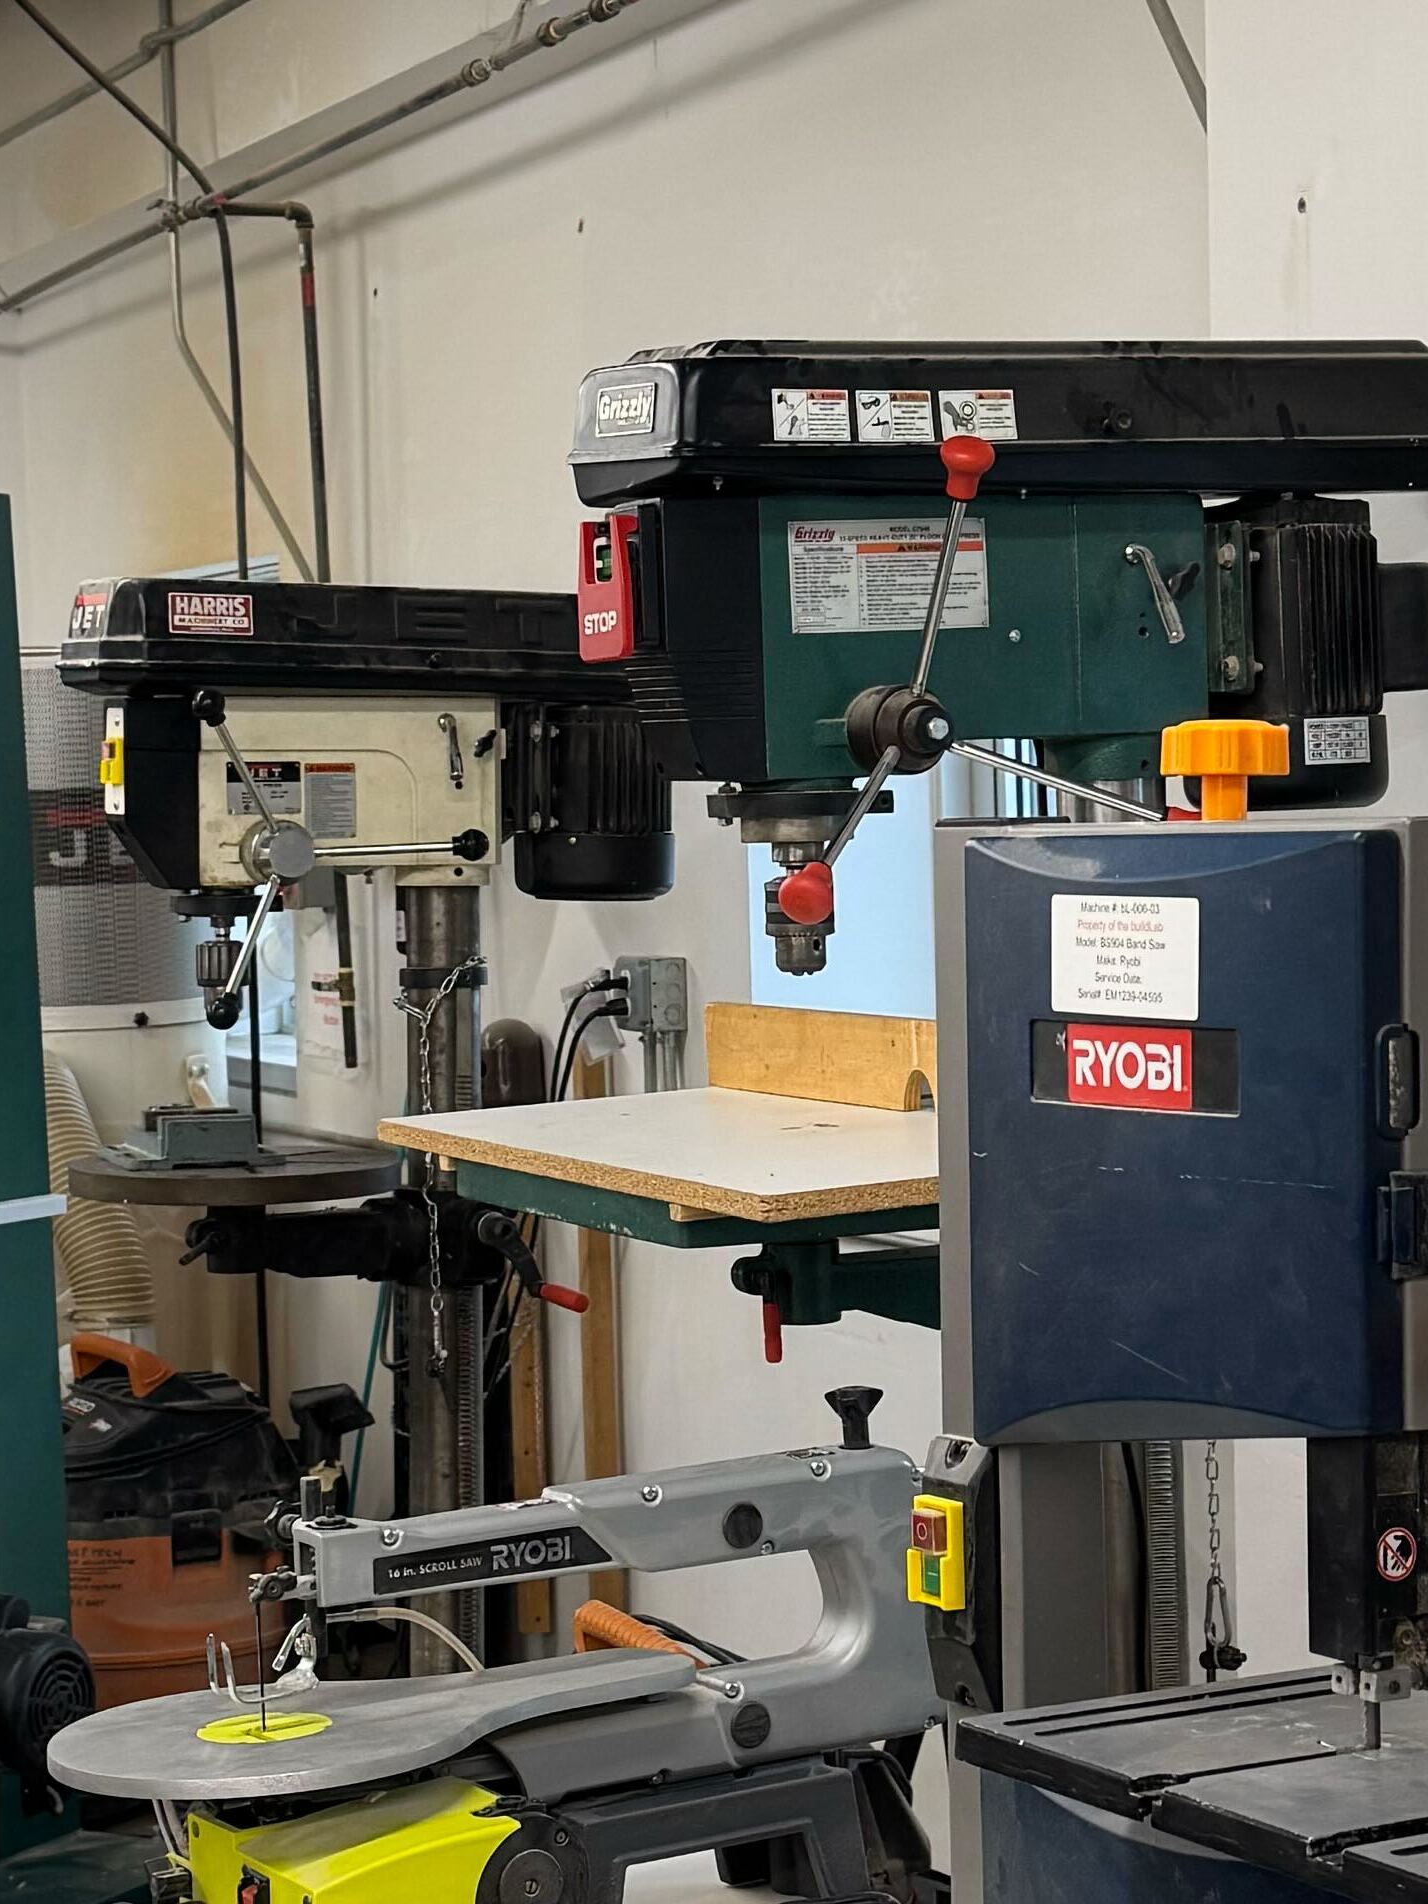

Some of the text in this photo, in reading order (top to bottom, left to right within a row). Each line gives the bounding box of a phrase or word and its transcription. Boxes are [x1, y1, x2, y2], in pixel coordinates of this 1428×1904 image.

[599, 391, 652, 424] Grizzly
[794, 526, 836, 543] Grizzly
[175, 595, 246, 617] HARRIS
[71, 604, 106, 630] JET
[584, 610, 617, 636] STOP
[1080, 902, 1111, 914] Machine
[1077, 919, 1107, 933] Property
[1108, 920, 1116, 932] of
[1117, 921, 1130, 932] the
[1126, 938, 1147, 950] Band
[1148, 938, 1166, 950] Saw
[1119, 955, 1142, 968] Ryobi
[1094, 971, 1121, 984] Service
[1072, 1039, 1182, 1093] RYOBI
[387, 1535, 572, 1579] 16 in. SCROLL SAW RYOBI
